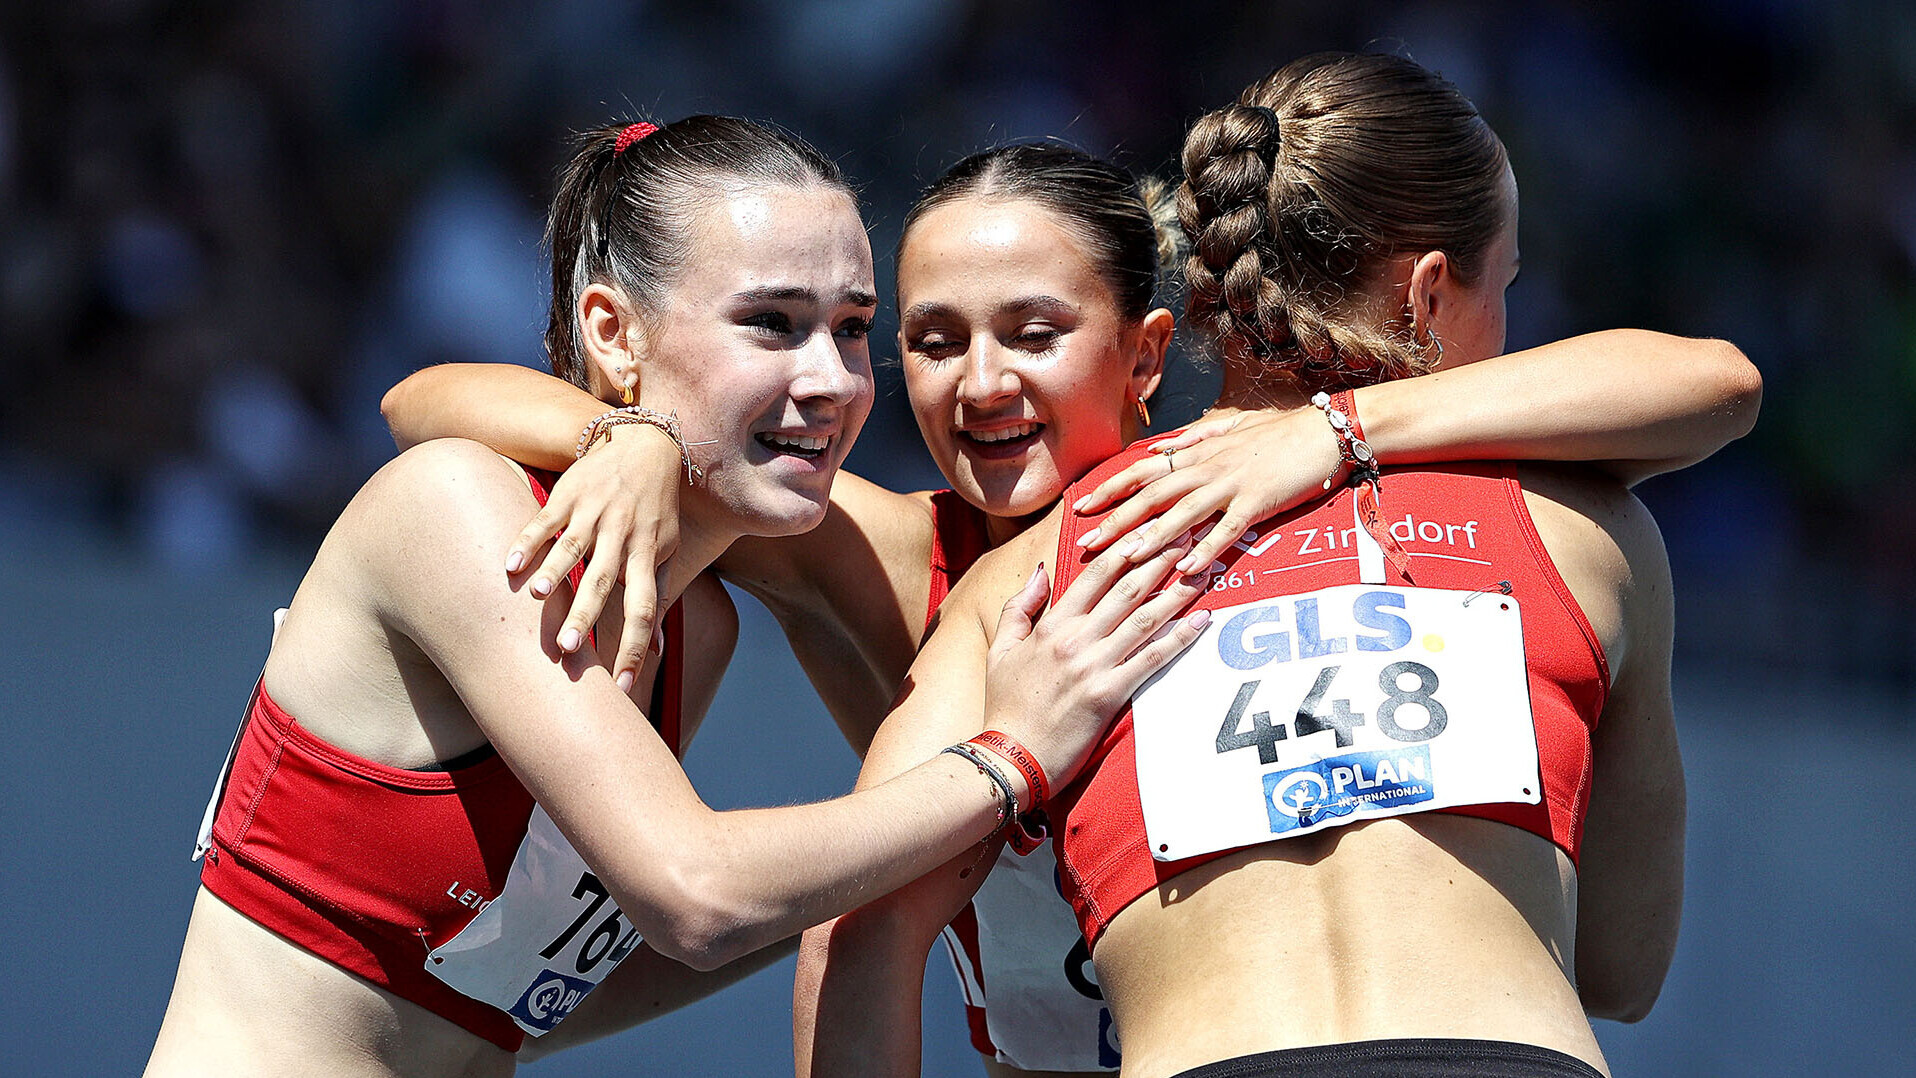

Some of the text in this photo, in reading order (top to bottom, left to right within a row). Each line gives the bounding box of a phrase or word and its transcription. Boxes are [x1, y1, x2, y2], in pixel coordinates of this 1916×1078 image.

[1294, 513, 1479, 556] Zirdorf
[1204, 569, 1255, 594] 861
[1215, 660, 1449, 764] 448
[1332, 755, 1425, 795] PLAN
[1338, 784, 1426, 808] INTERNATIONAL
